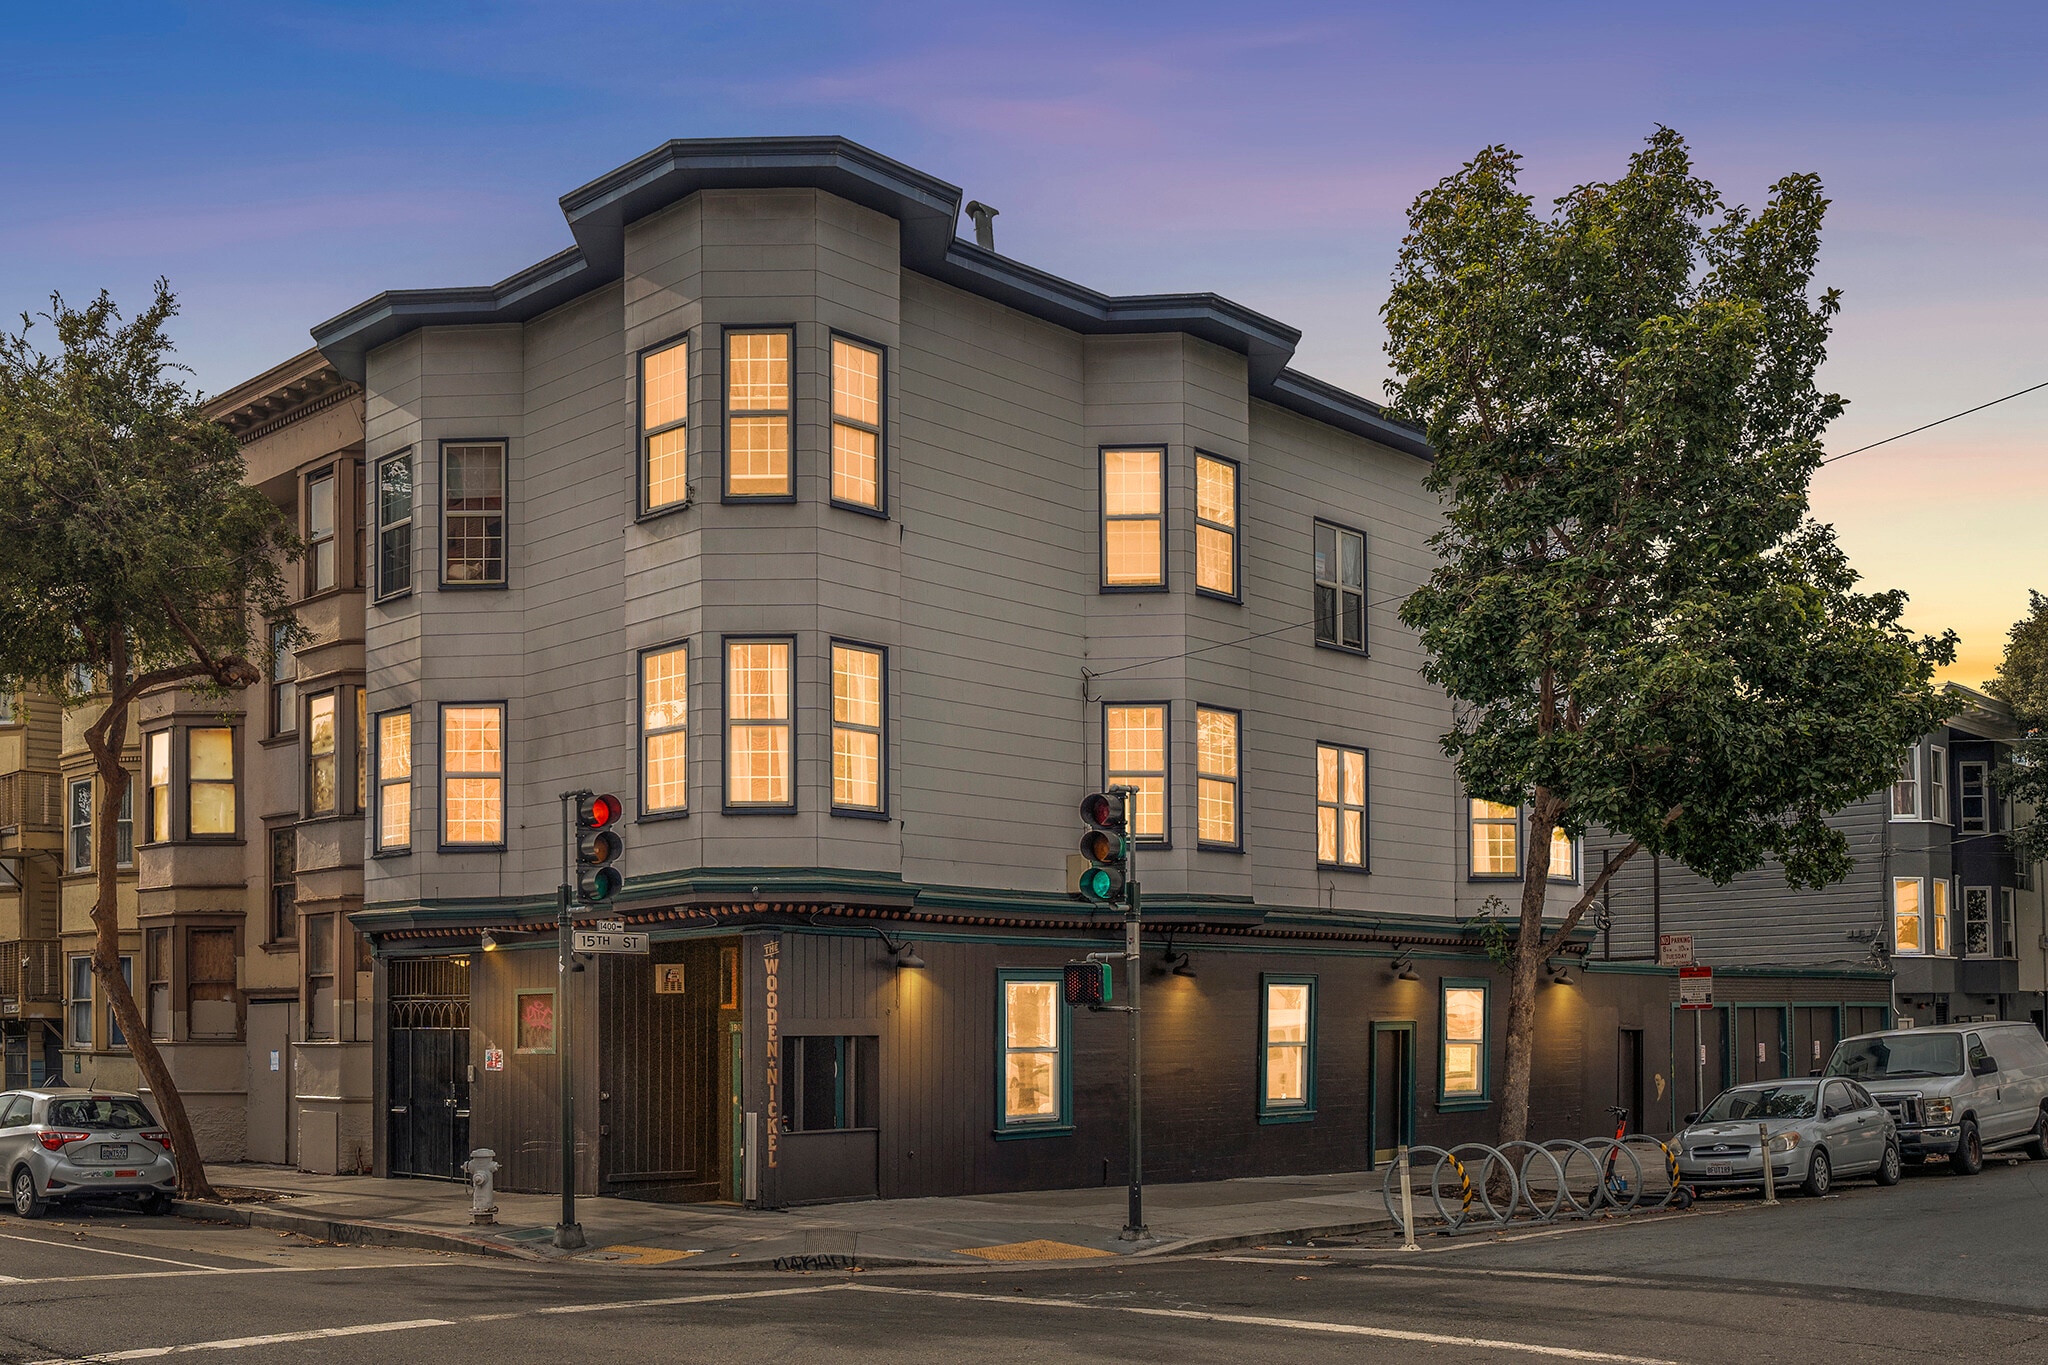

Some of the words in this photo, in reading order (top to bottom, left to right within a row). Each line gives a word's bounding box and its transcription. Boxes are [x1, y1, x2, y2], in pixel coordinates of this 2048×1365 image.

[600, 922, 616, 931] 1400
[581, 936, 610, 947] 15TH
[623, 937, 639, 948] ST
[1660, 936, 1670, 945] NO
[764, 944, 779, 955] THE
[764, 959, 779, 1058] WOODEN
[767, 1068, 778, 1168] NICKEL
